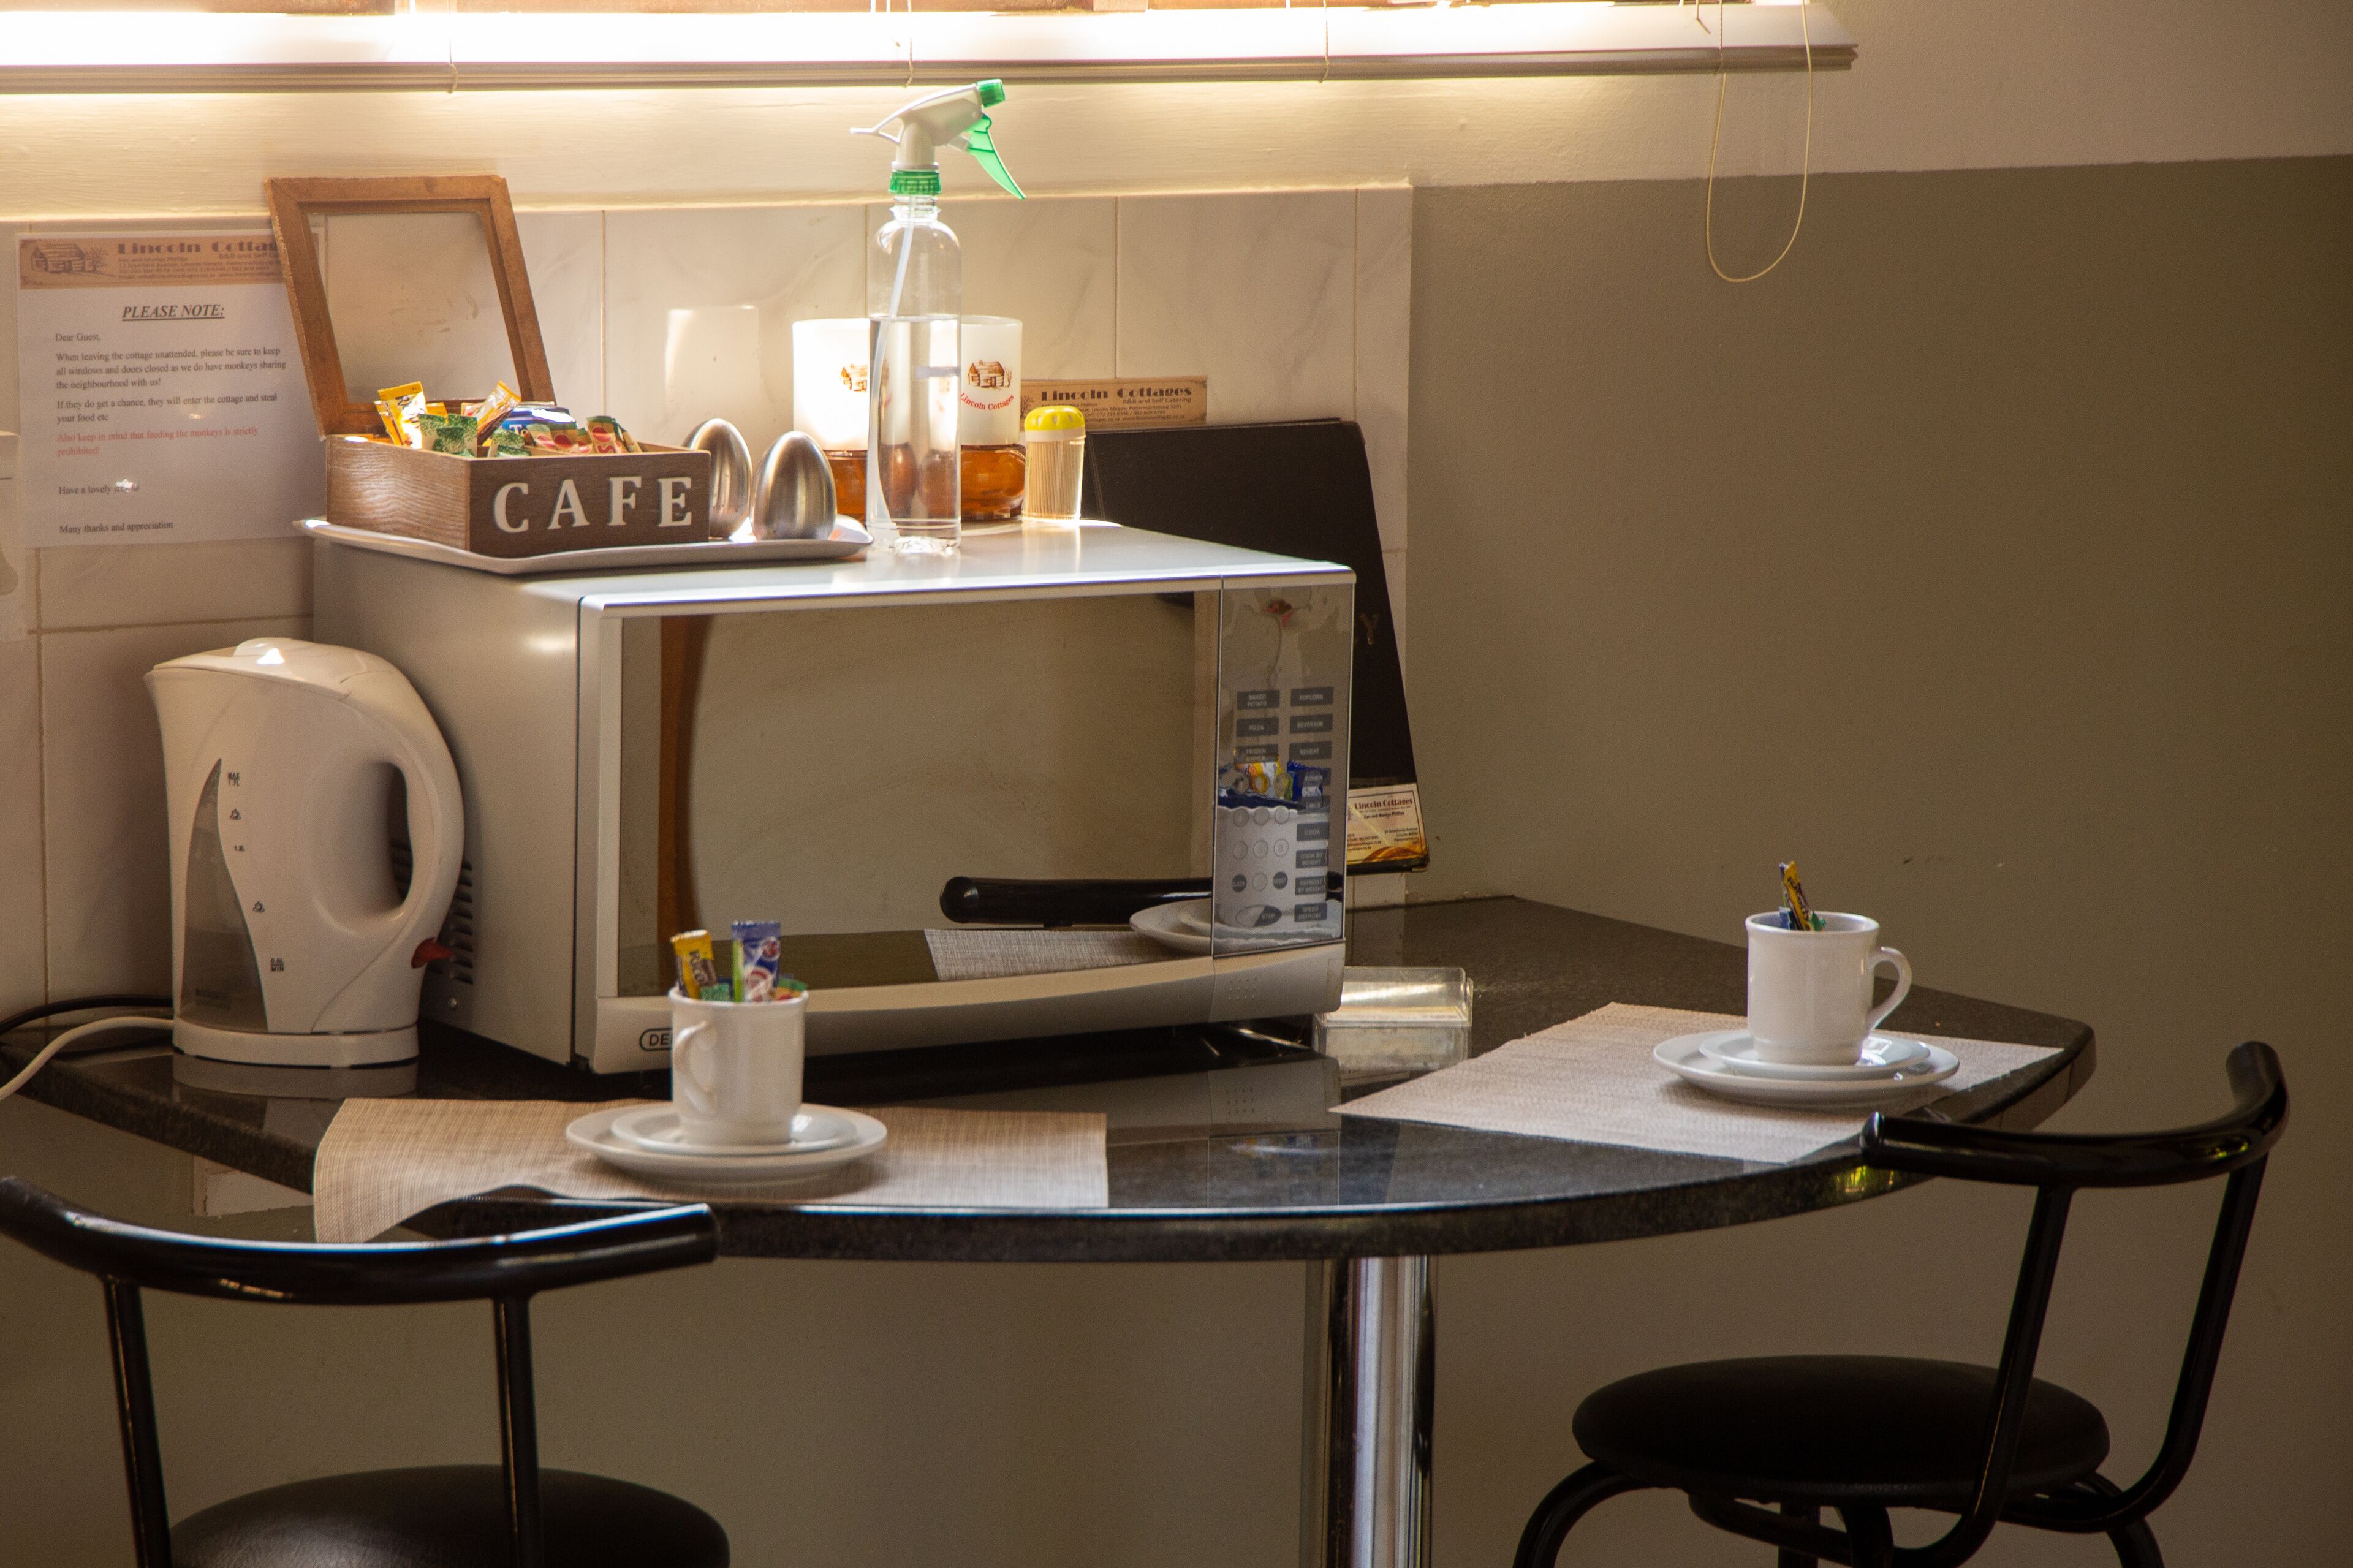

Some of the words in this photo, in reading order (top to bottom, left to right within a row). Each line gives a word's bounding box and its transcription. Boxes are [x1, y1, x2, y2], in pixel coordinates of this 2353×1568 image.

[118, 243, 200, 254] Lincoln
[122, 305, 178, 320] PLEASE
[181, 304, 225, 318] NOTE:
[55, 333, 74, 341] Dear
[56, 353, 78, 362] When
[81, 352, 110, 362] leaving
[126, 352, 153, 362] cottage
[200, 349, 224, 359] please
[225, 348, 235, 357] be
[263, 347, 280, 357] keep
[145, 364, 169, 373] closed
[224, 362, 258, 371] monkeys
[260, 360, 286, 369] sharing
[70, 379, 128, 390] neighbourhood
[1042, 389, 1108, 401] Lincoln
[1117, 387, 1192, 398] Cottages
[66, 400, 82, 410] they
[97, 401, 108, 410] get
[148, 398, 164, 407] they
[167, 396, 181, 405] will
[217, 395, 243, 404] cottage
[960, 393, 986, 410] Lincoln
[988, 395, 1014, 411] Cottages
[58, 415, 75, 424] your
[77, 413, 95, 422] food
[58, 433, 75, 442] Also
[78, 433, 96, 443] keep
[146, 430, 174, 440] feeding
[176, 430, 187, 438] the
[190, 428, 223, 438] monkeys
[233, 426, 257, 436] strictly
[57, 446, 100, 458] prohibited!
[59, 486, 79, 494] Have
[88, 485, 111, 495] lovely
[493, 476, 692, 532] CAFE
[59, 526, 80, 535] Many
[84, 524, 109, 532] thanks
[111, 523, 124, 531] and
[127, 521, 173, 532] appreciation
[1354, 800, 1382, 809] Lincoln
[1383, 798, 1413, 808] Cottages
[650, 1033, 670, 1046] DE
